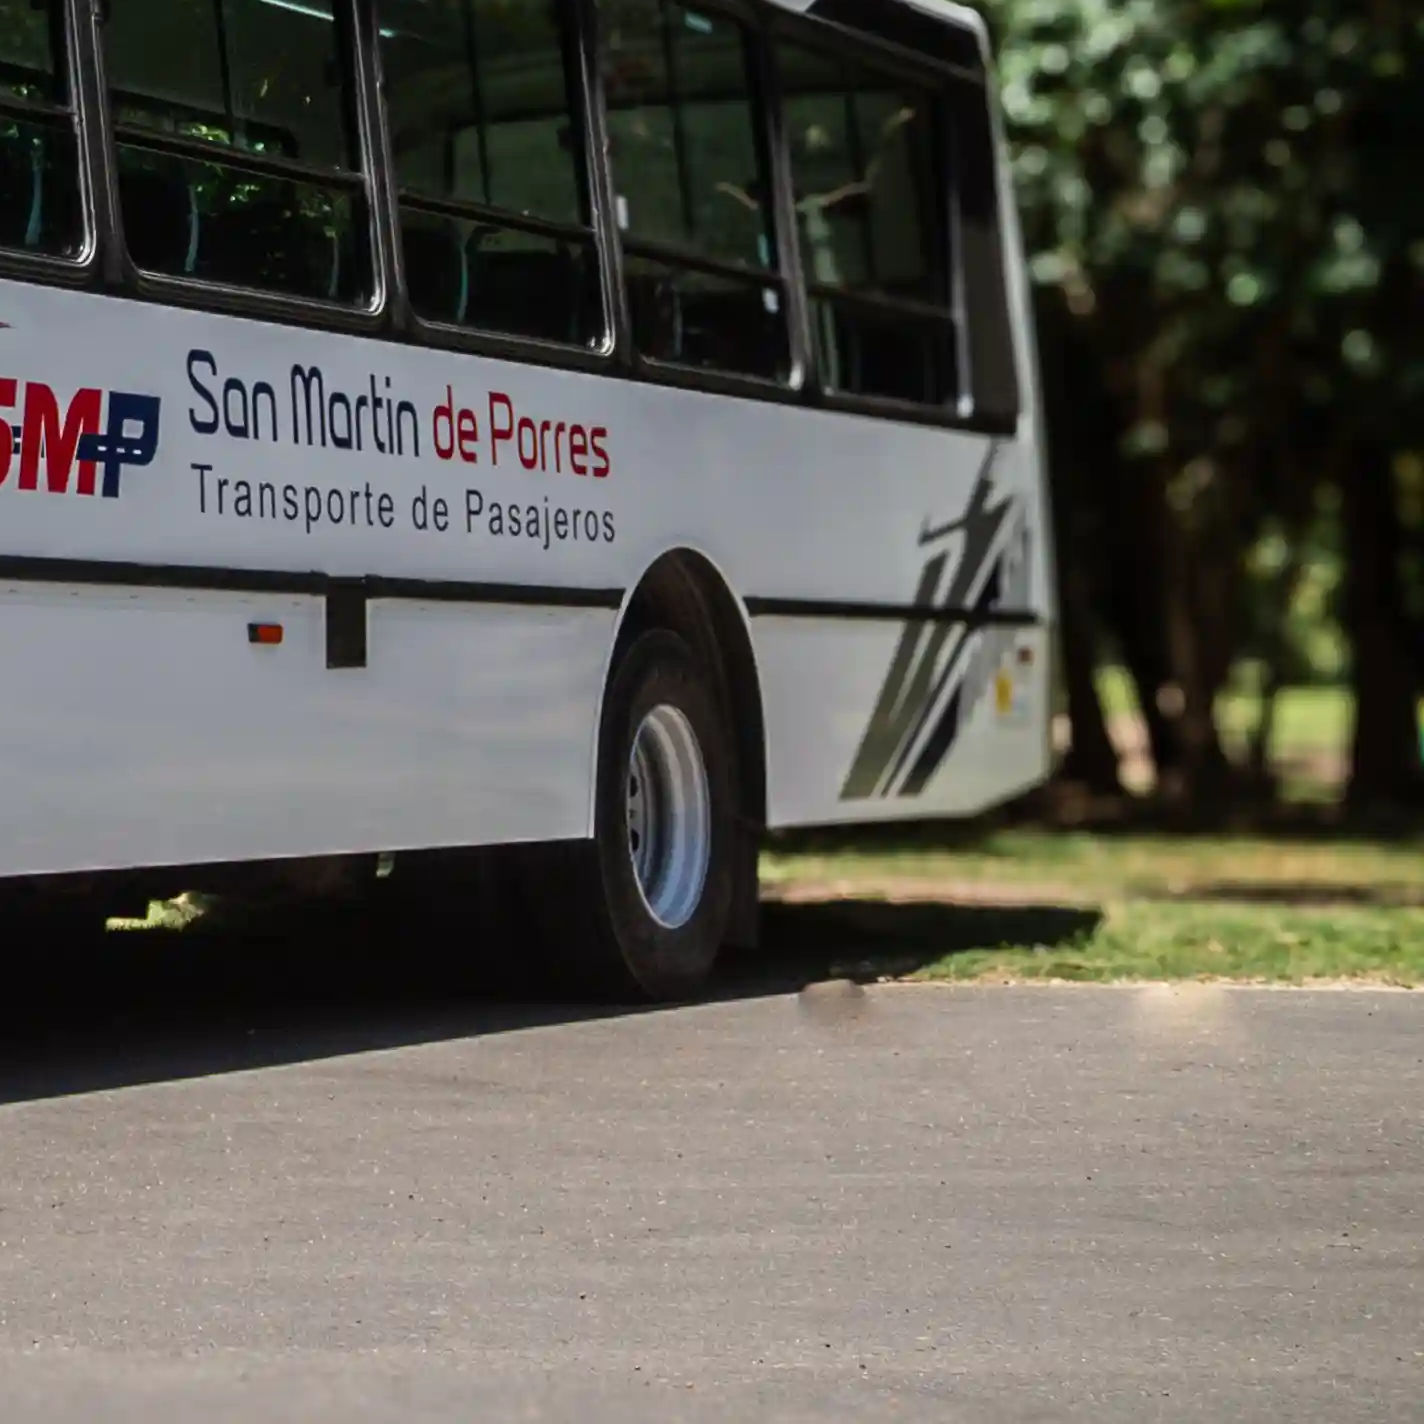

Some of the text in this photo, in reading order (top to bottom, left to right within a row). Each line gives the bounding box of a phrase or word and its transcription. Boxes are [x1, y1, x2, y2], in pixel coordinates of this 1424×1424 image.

[186, 349, 611, 478] San Martin de Porres
[190, 463, 616, 550] Transporte de Pasajeros
